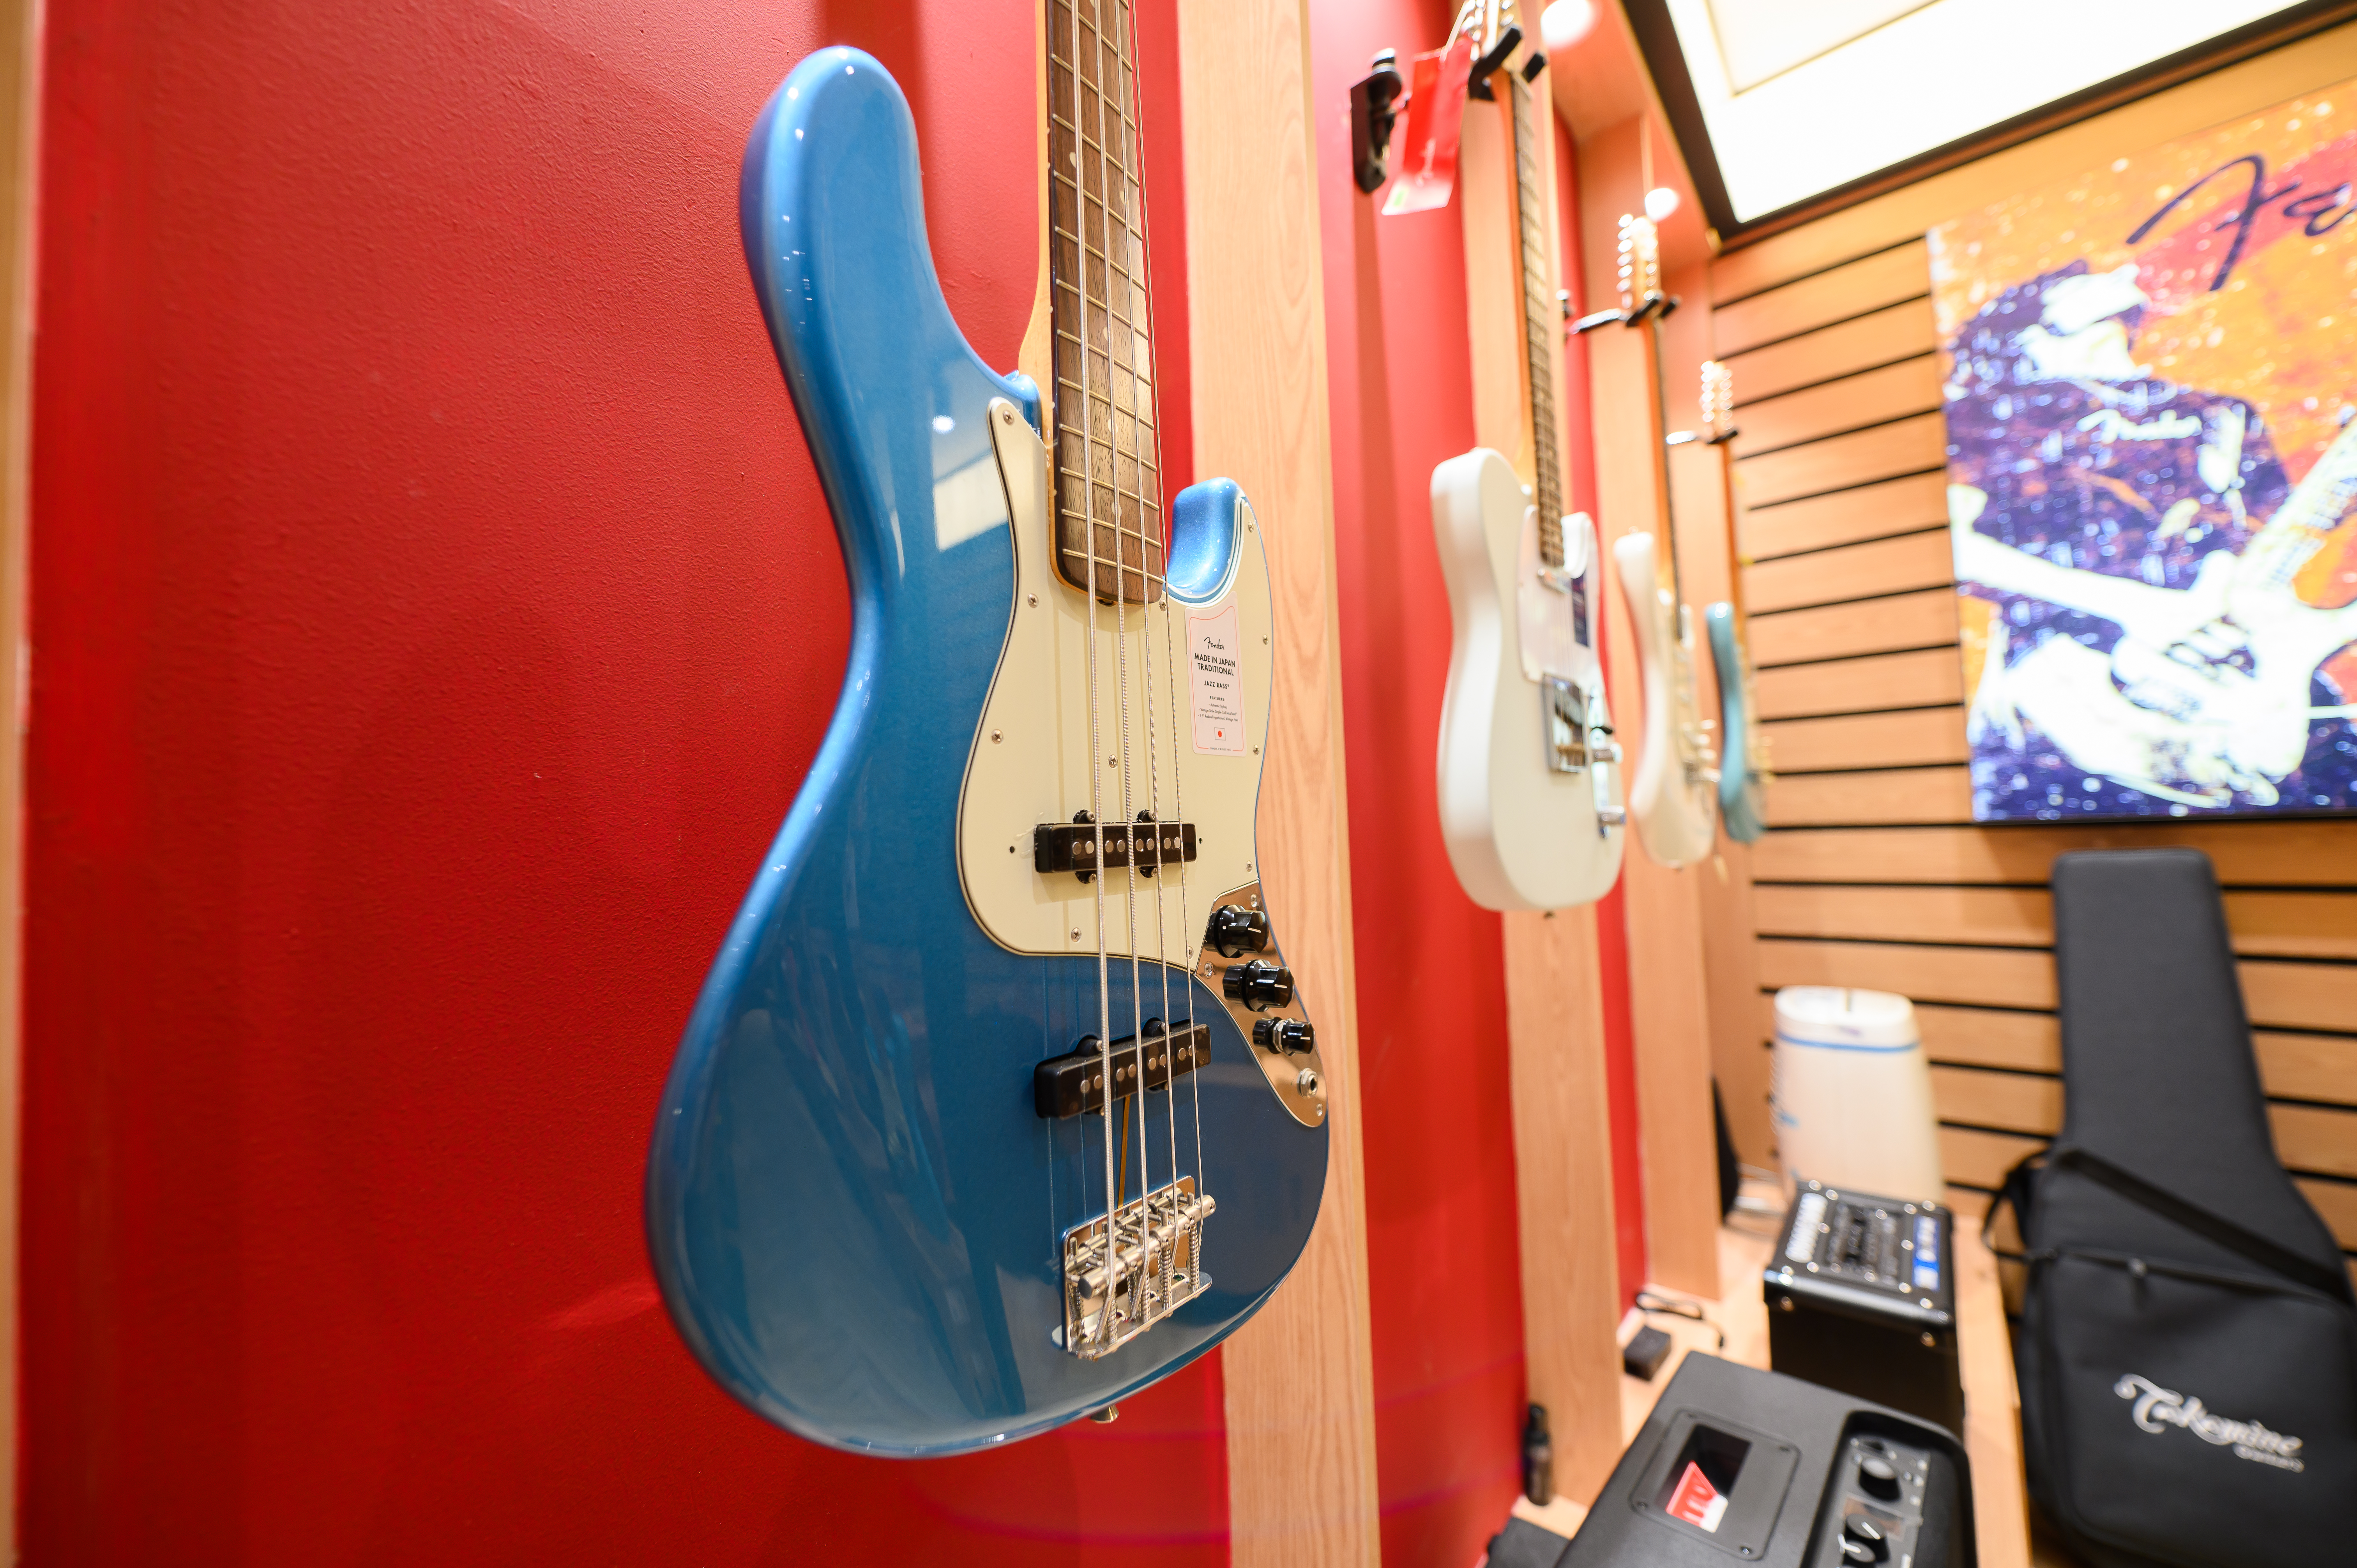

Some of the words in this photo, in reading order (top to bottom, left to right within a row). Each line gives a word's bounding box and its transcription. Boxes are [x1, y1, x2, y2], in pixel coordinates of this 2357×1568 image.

[1204, 637, 1224, 650] Fender
[1194, 653, 1210, 662] MADE
[1219, 658, 1235, 667] JAPAN
[1198, 662, 1234, 676] TRADITIONAL
